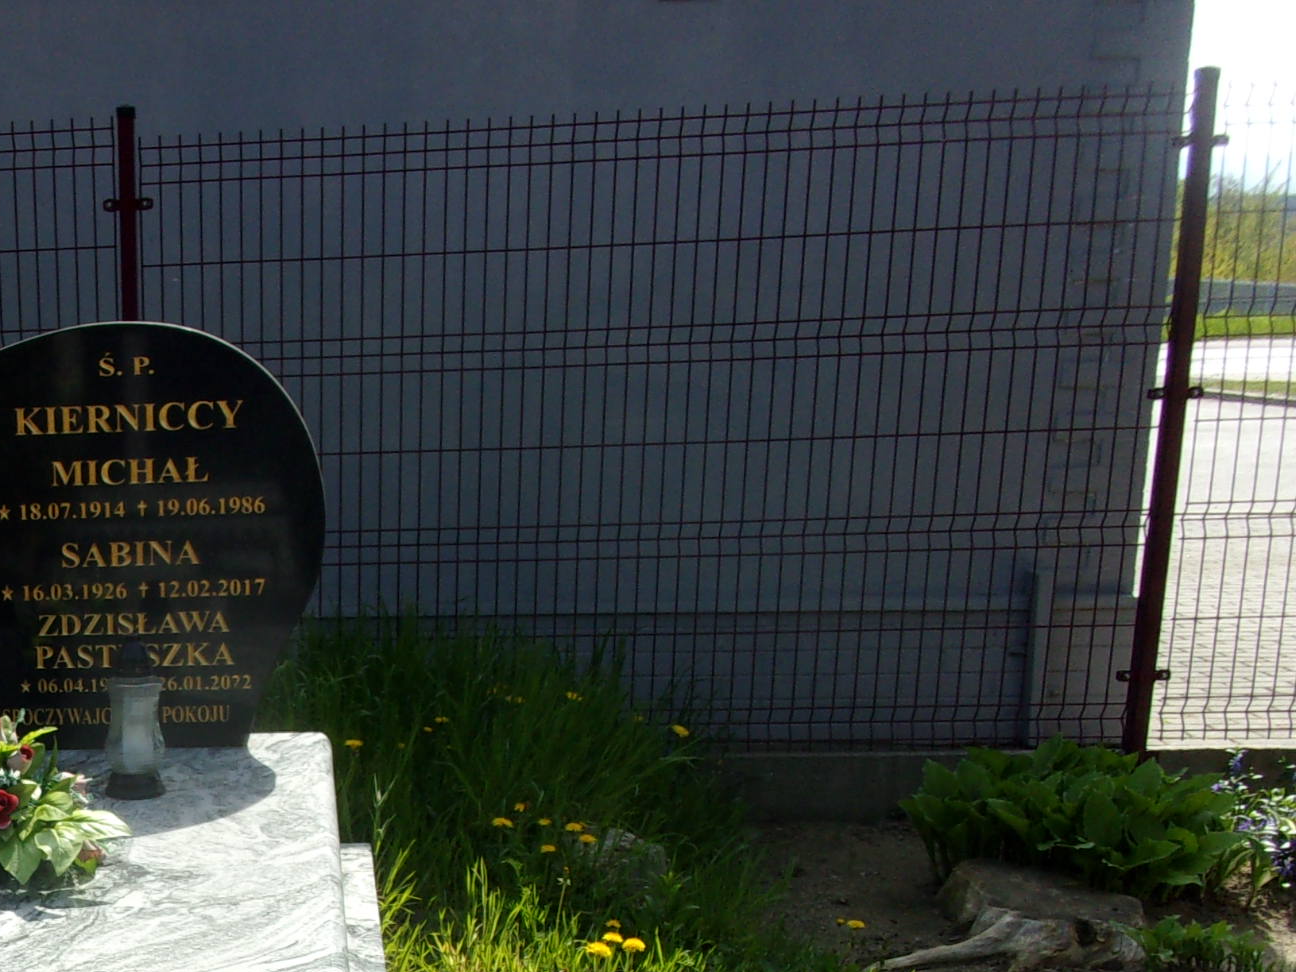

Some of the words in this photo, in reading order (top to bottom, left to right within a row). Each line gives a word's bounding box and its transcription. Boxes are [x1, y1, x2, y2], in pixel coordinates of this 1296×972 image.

[98, 352, 123, 377] Ś.
[133, 356, 155, 376] P.
[15, 399, 244, 436] KIERNICCY
[51, 456, 209, 487] MICHAŁ
[19, 501, 126, 521] 18.07.1914
[157, 496, 266, 517] 19.06.1986
[61, 540, 201, 568] SABINA
[22, 583, 128, 601] 16.03.1926
[159, 578, 266, 599] 12.02.2017
[38, 610, 230, 637] ZDZISŁAWA
[34, 642, 235, 669] PASTSZKA
[162, 705, 230, 723] POKOJU
